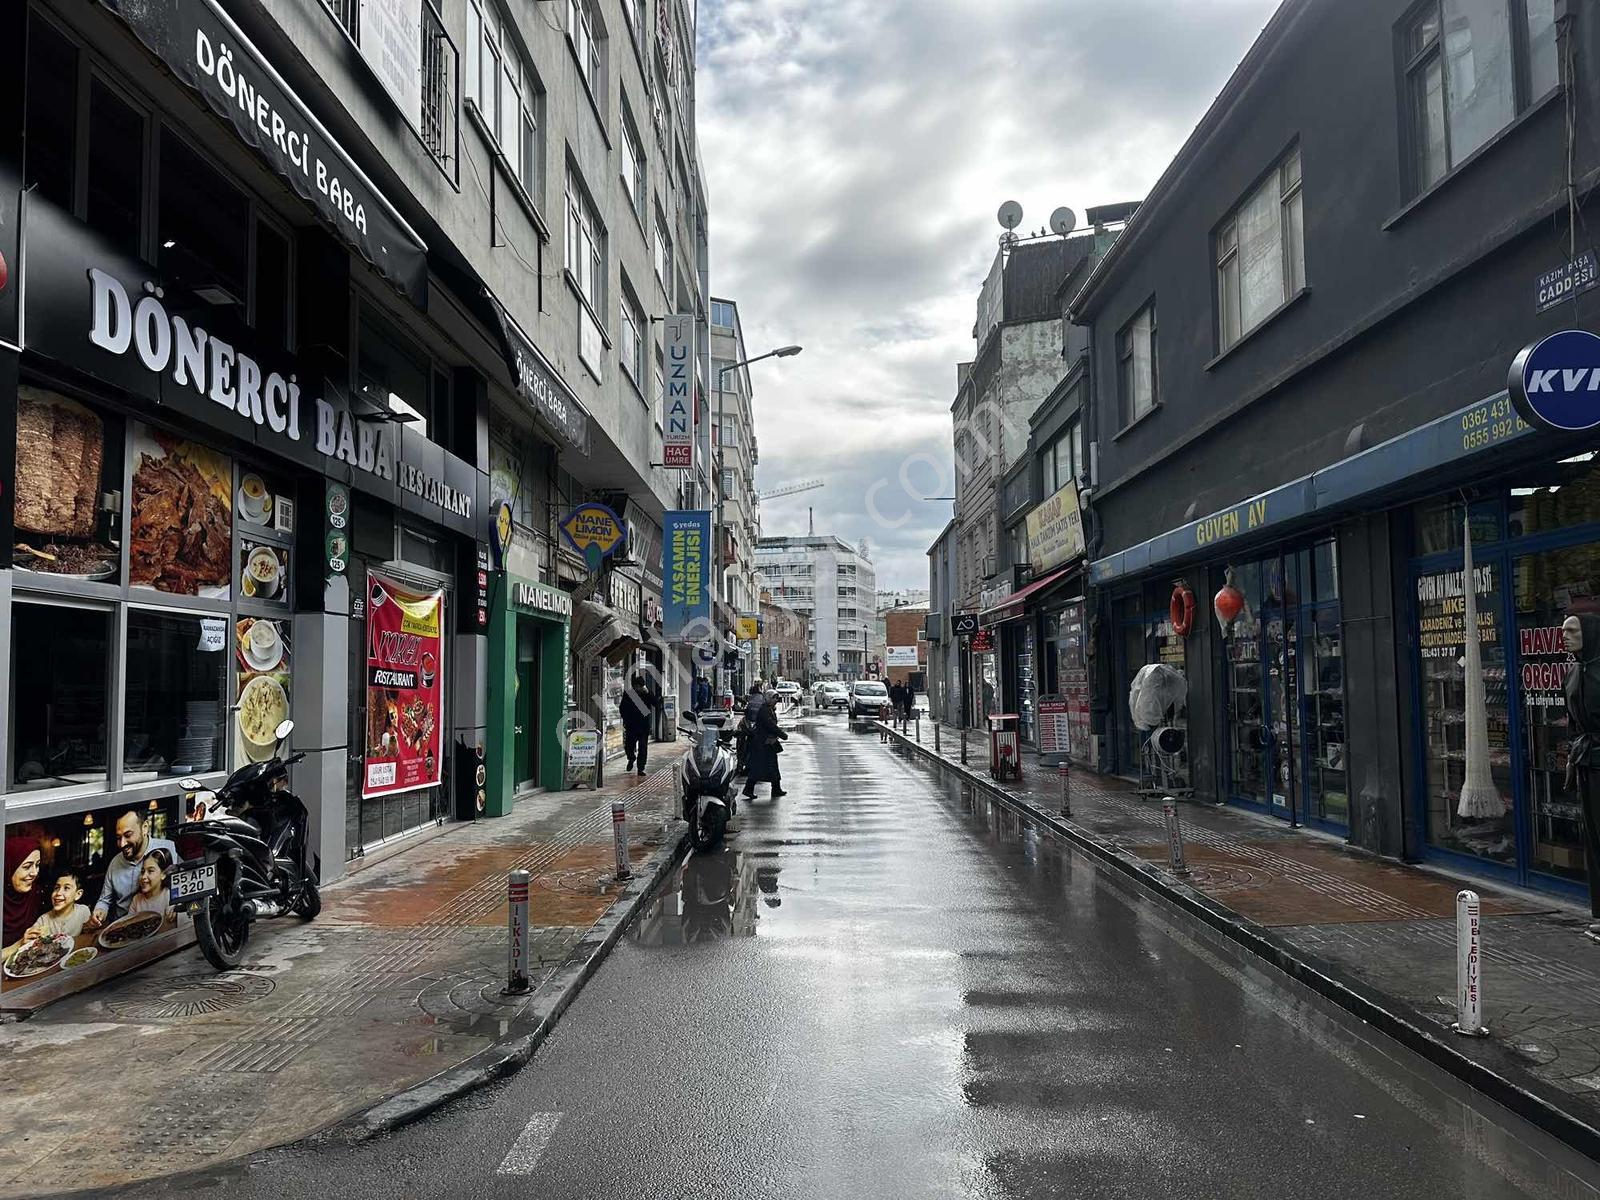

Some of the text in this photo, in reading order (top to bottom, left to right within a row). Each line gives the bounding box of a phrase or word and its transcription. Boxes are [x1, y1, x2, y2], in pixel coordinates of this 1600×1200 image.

[196, 28, 368, 236] DÖNERCİ BABA
[1539, 264, 1593, 303] CADDESİ
[1540, 268, 1564, 287] KAZIM
[88, 267, 473, 520] DÖNERCİ BABA RESTAURANT
[516, 349, 567, 425] ÖNERCİ BABA
[669, 345, 688, 433] UZMAN
[1462, 398, 1511, 431] 0362 431
[1463, 427, 1489, 450] 0555
[1492, 418, 1513, 440] 992
[665, 456, 690, 465] UMRE
[666, 447, 689, 456] HAC
[576, 514, 612, 527] NANE
[1196, 499, 1268, 545] GÜVEN AV
[687, 530, 701, 606] ENERJİSİ
[519, 582, 573, 616] NANELIMON
[1442, 598, 1465, 615] MKE
[1444, 630, 1466, 645] MADDELE
[1519, 626, 1568, 656] HAVA
[172, 866, 214, 885] 55 APD
[181, 880, 204, 895] 320
